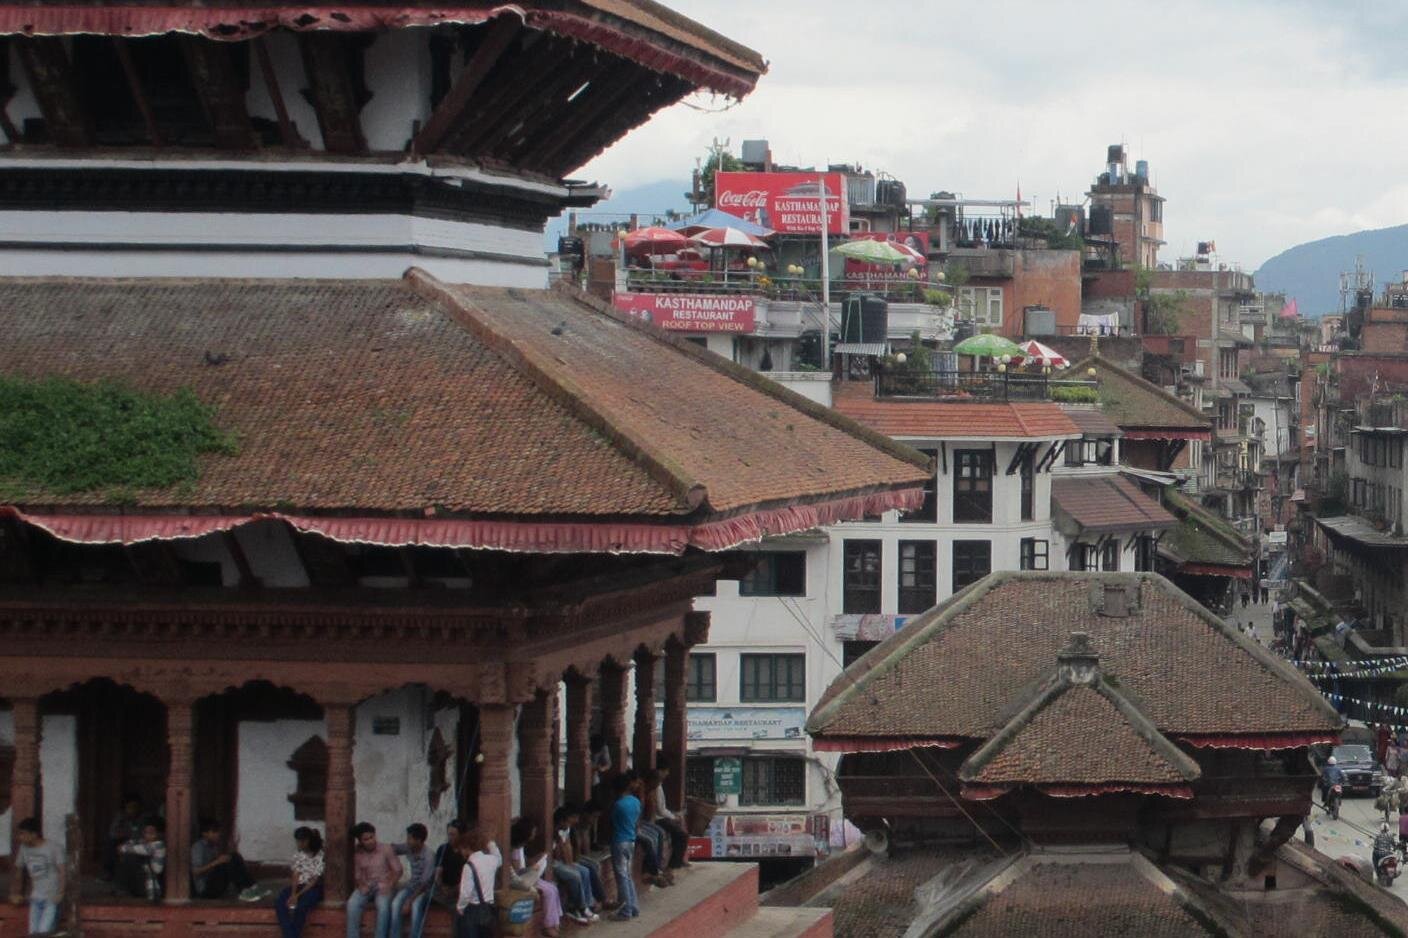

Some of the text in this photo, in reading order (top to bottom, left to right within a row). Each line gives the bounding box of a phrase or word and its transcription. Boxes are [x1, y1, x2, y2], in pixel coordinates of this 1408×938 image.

[719, 190, 768, 208] Coca-Cola
[782, 214, 832, 224] RESTAURAT
[656, 297, 752, 311] KASTHAMANDAP
[673, 310, 735, 321] RESTAURANT
[662, 320, 744, 331] ROOF TOP VIEW
